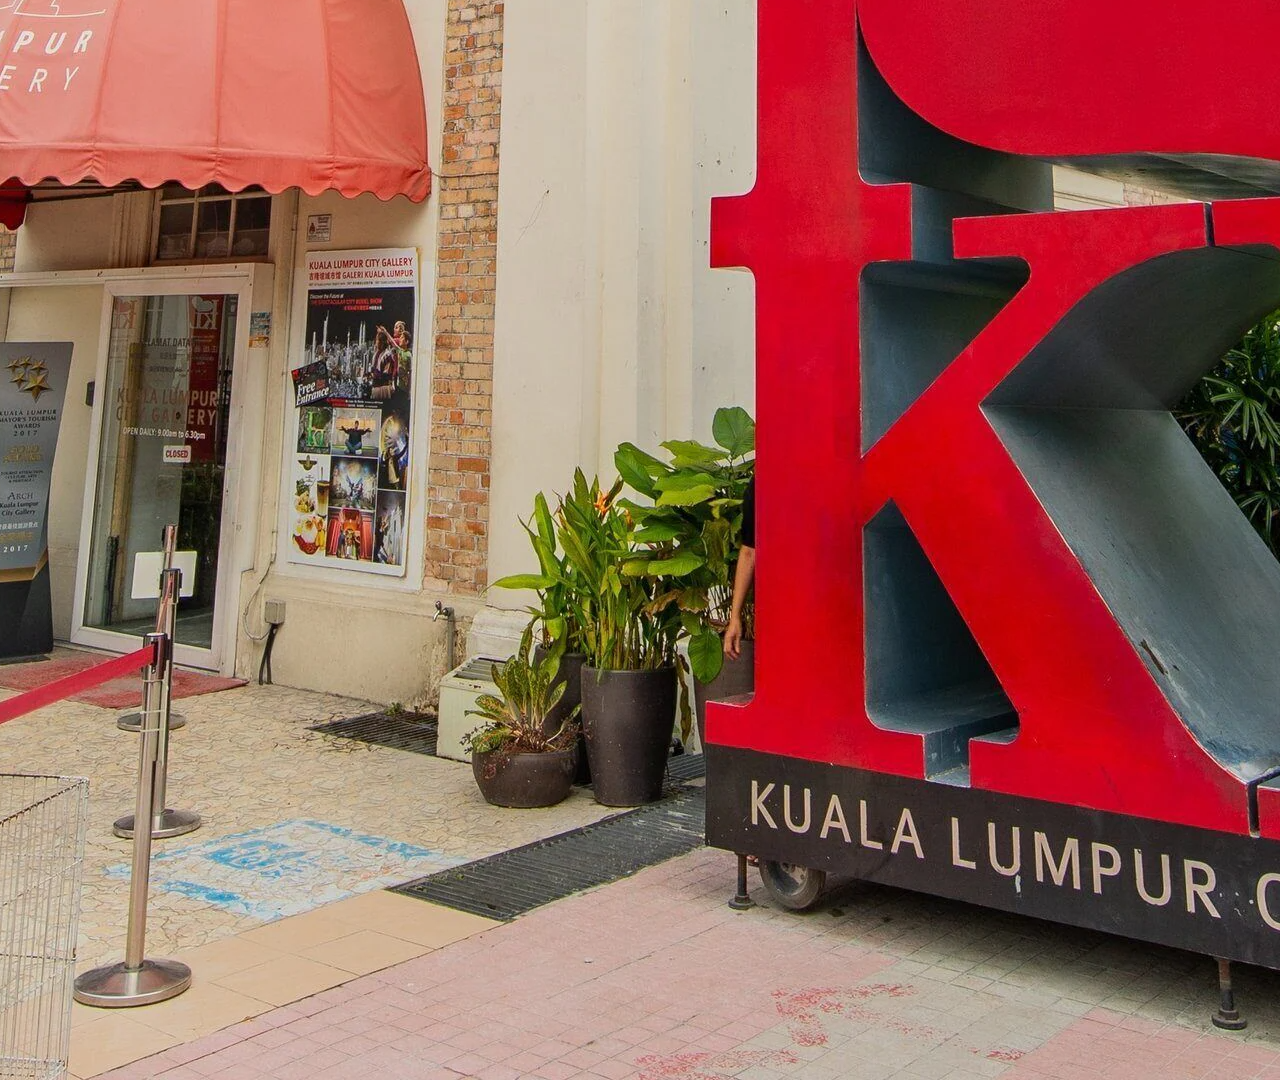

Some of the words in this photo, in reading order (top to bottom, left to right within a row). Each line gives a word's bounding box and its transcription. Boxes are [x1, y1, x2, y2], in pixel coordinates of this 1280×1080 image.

[309, 261, 333, 270] KUALA
[333, 259, 363, 269] LUMPUR
[365, 258, 380, 268] CITY
[381, 257, 413, 267] GALLERY
[342, 271, 363, 280] GALERI
[364, 270, 386, 279] KUALA
[386, 269, 414, 278] LUMPUR
[297, 381, 316, 396] Free
[296, 386, 330, 406] Entrance
[123, 426, 138, 435] OPEN
[157, 428, 177, 437] 9.00am
[178, 430, 184, 438] to
[184, 430, 206, 440] 6.30pm
[165, 449, 189, 459] CLOSED
[7, 492, 33, 500] ARCH
[15, 508, 36, 516] Gallery
[3, 544, 29, 553] 2017
[749, 779, 926, 860] KUALA
[950, 816, 1222, 920] LUMPUR
